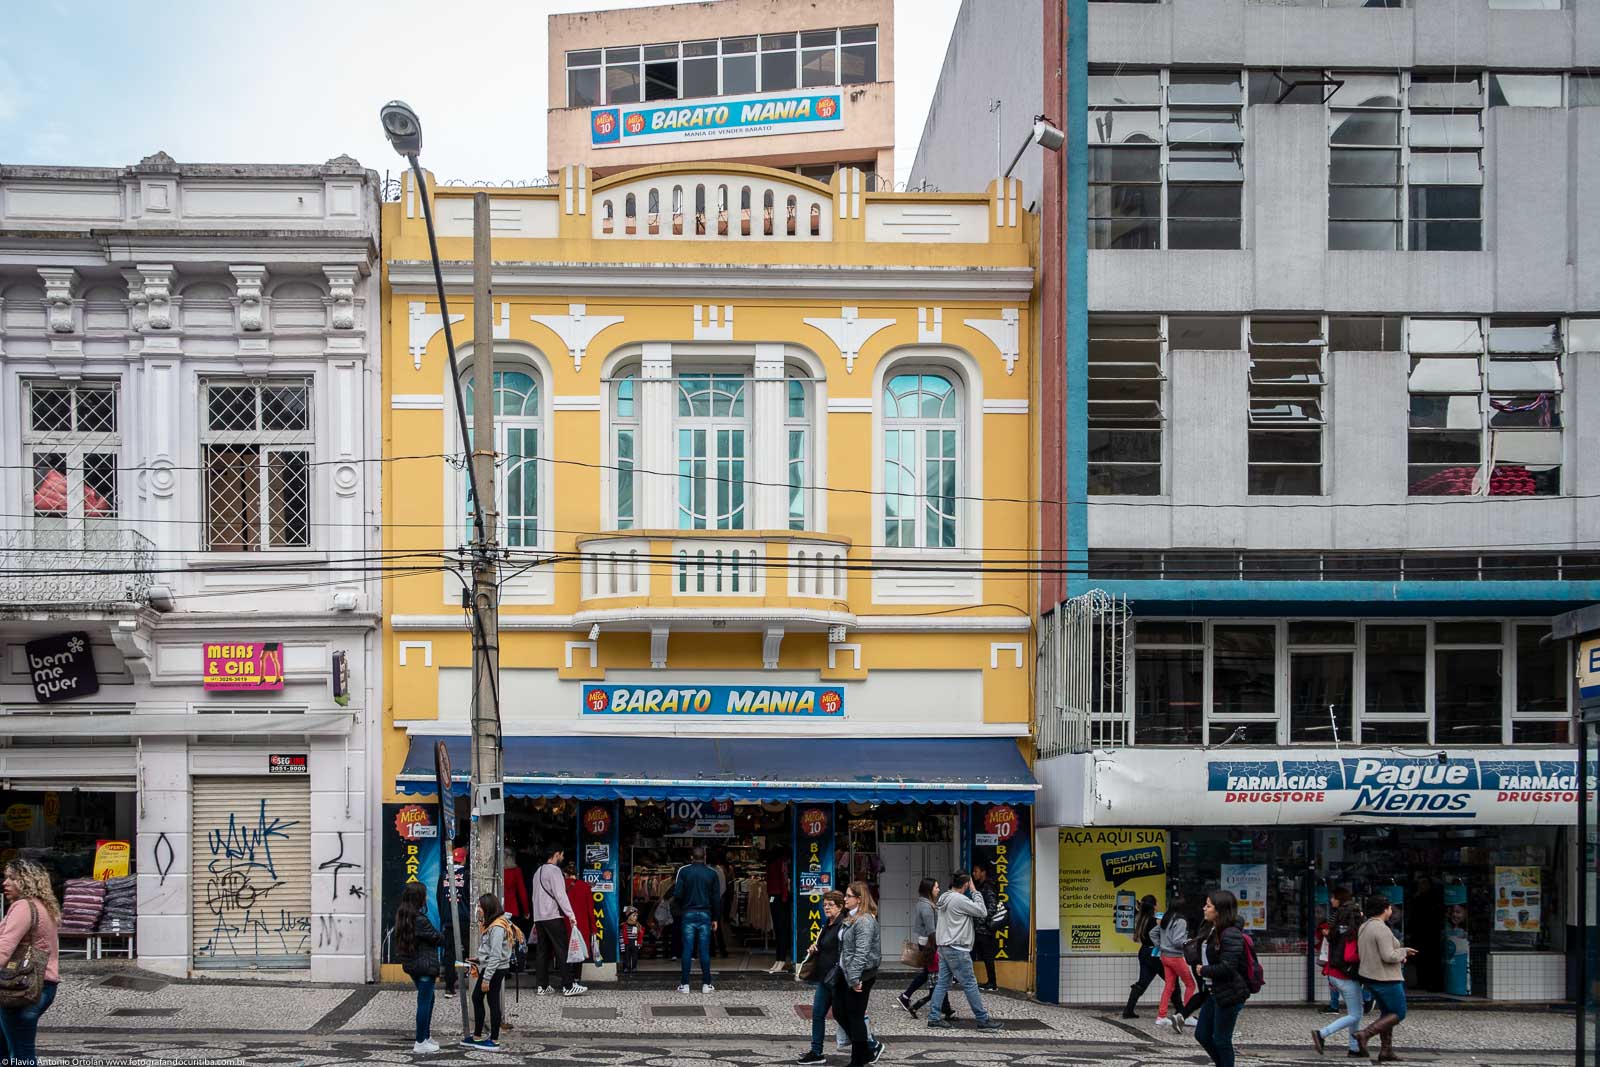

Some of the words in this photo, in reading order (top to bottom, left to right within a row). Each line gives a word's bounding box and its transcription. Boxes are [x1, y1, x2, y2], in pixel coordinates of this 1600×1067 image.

[651, 105, 729, 130] BARATO
[741, 98, 811, 122] MANIA
[822, 107, 832, 118] 10
[600, 123, 611, 133] 10
[631, 123, 641, 133] 10
[207, 645, 254, 659] MEIAS
[30, 652, 73, 669] bem
[34, 667, 63, 682] me
[209, 661, 219, 675] &
[224, 661, 255, 675] CIA
[37, 677, 77, 698] quer
[589, 692, 607, 701] MEGA
[610, 688, 712, 713] BARATO
[726, 690, 815, 713] MANIA
[822, 694, 840, 703] MEGA
[592, 700, 603, 711] 10
[825, 701, 837, 712] 10
[1226, 773, 1328, 790] FARMÁCIAS
[1353, 759, 1470, 790] Pague
[1498, 774, 1597, 790] FARMÁCIS
[1225, 791, 1325, 803] DRUGSTORE
[1351, 785, 1471, 811] Menos
[400, 811, 426, 823] MEGA
[587, 811, 608, 821] MEGA
[666, 802, 703, 819] 10X
[804, 812, 825, 822] MEGA
[989, 810, 1015, 824] MEGA
[592, 820, 605, 832] 10
[809, 821, 821, 834] 10
[995, 822, 1010, 837] 10
[1058, 832, 1093, 846] FAÇA
[1097, 831, 1132, 846] AQUI
[1136, 831, 1165, 844] SUA
[1105, 851, 1159, 866] RECARGA
[1112, 861, 1157, 875] DIGITAL
[582, 874, 600, 883] 10X
[800, 878, 817, 886] 10X
